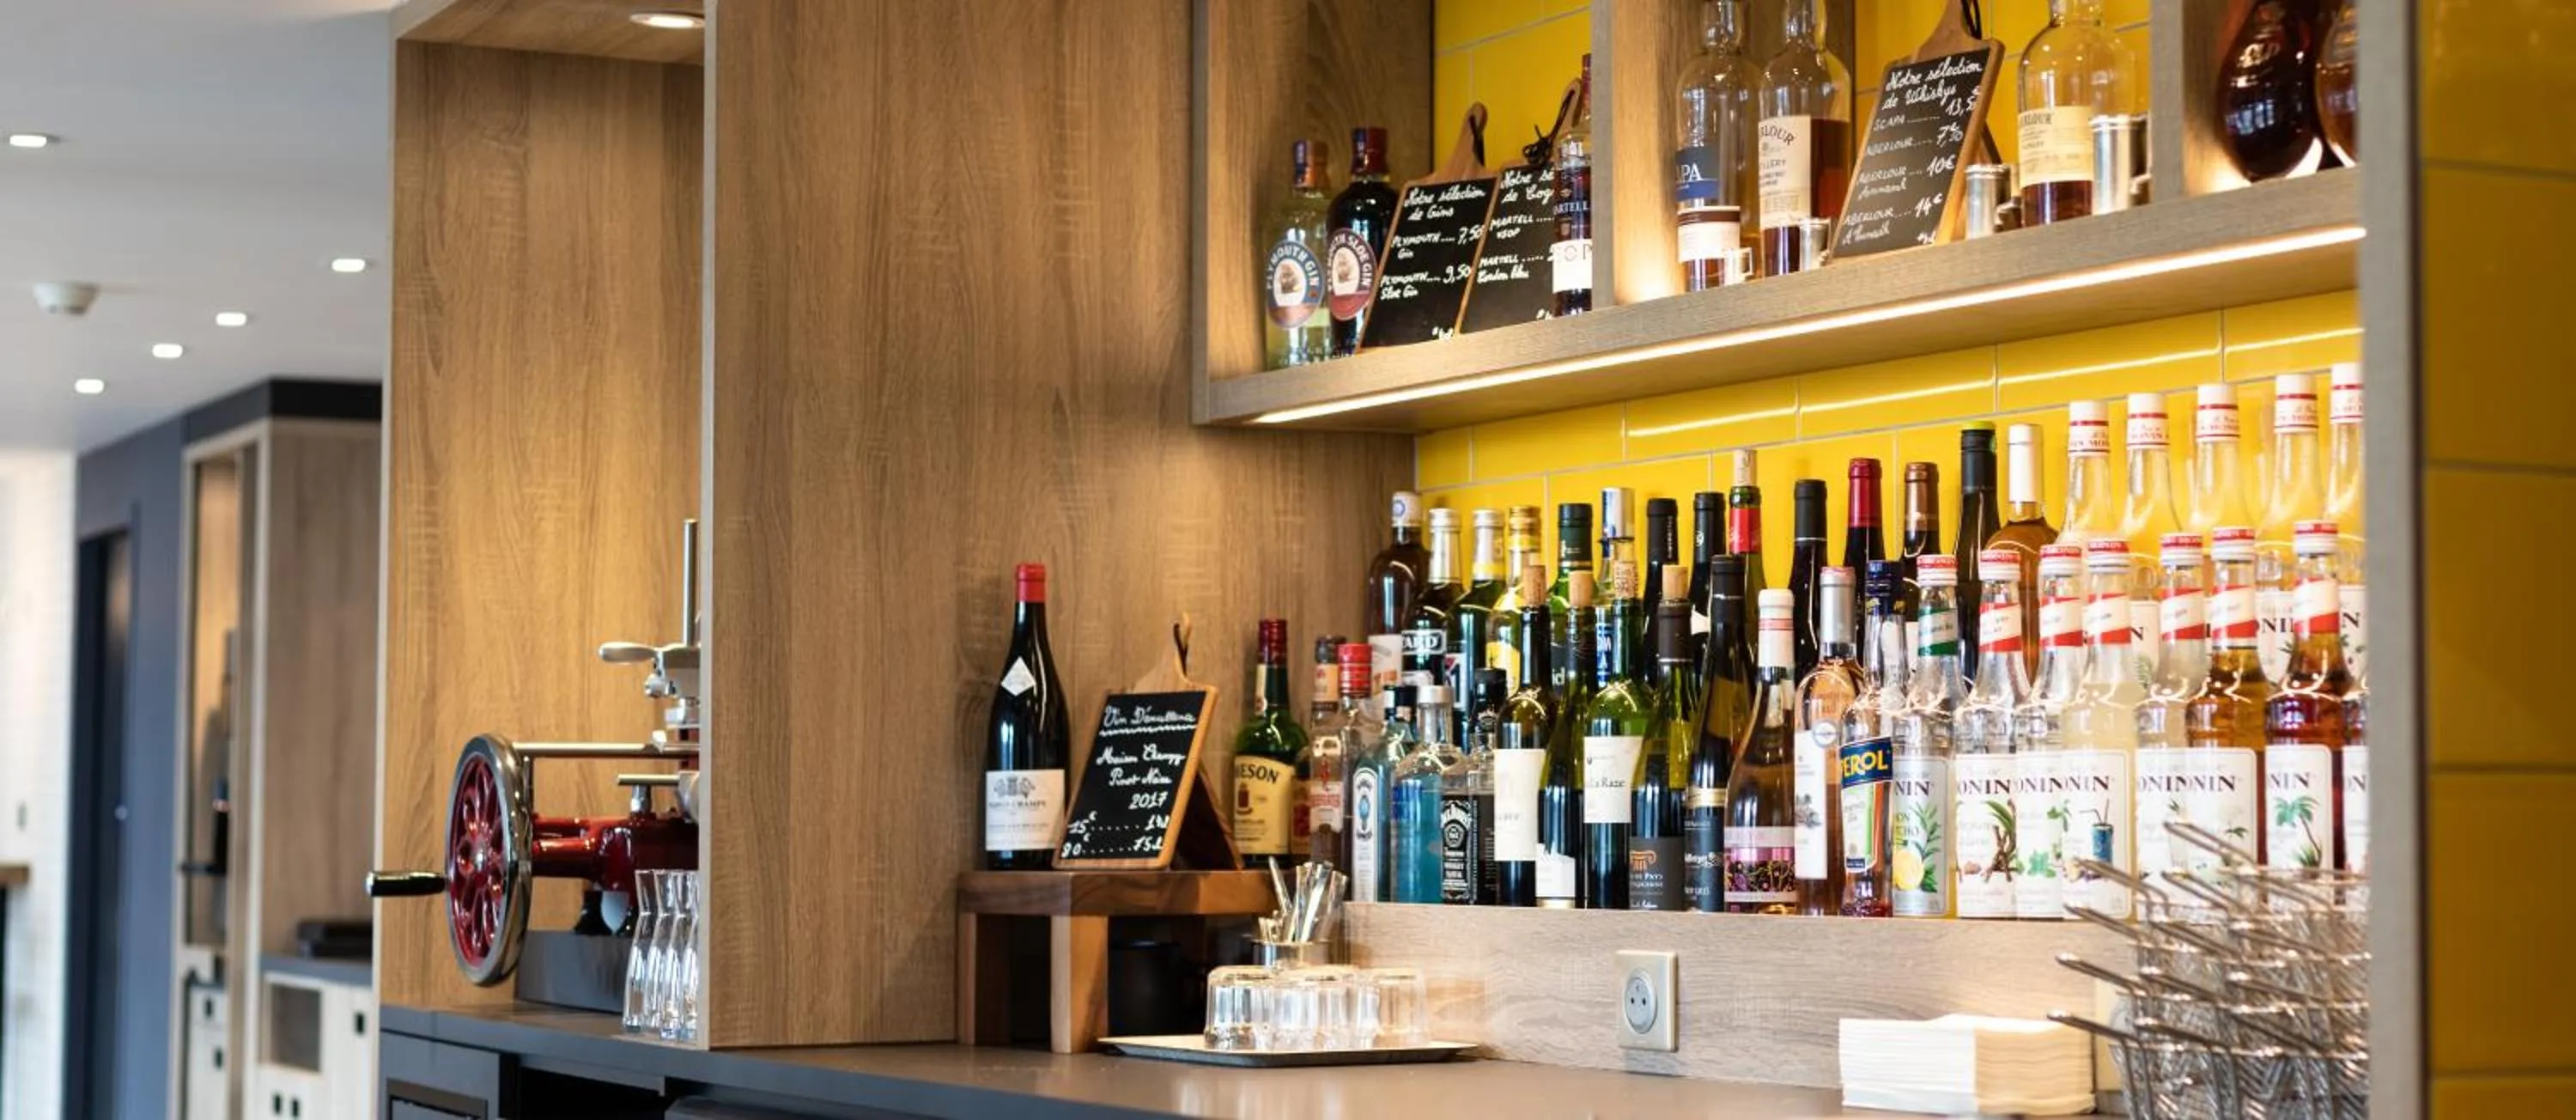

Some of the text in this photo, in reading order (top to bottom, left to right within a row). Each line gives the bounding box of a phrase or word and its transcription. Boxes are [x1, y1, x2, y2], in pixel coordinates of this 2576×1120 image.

[1885, 55, 1984, 92] Notre sélection
[1881, 91, 1899, 110] de
[1502, 184, 1554, 206] de Cog
[1408, 207, 1424, 221] de
[1553, 200, 1589, 216] ARTELL
[1490, 215, 1534, 232] MARTELL
[1304, 259, 1320, 287] GIN
[1361, 264, 1373, 287] GIN
[1402, 633, 1439, 650] ARD
[1842, 750, 1888, 777] EROL
[1240, 763, 1279, 784] ESON
[2269, 772, 2311, 789] NIN
[1895, 781, 1931, 796] NIN
[1958, 779, 2012, 795] ONIN
[1127, 791, 1169, 810] 2017
